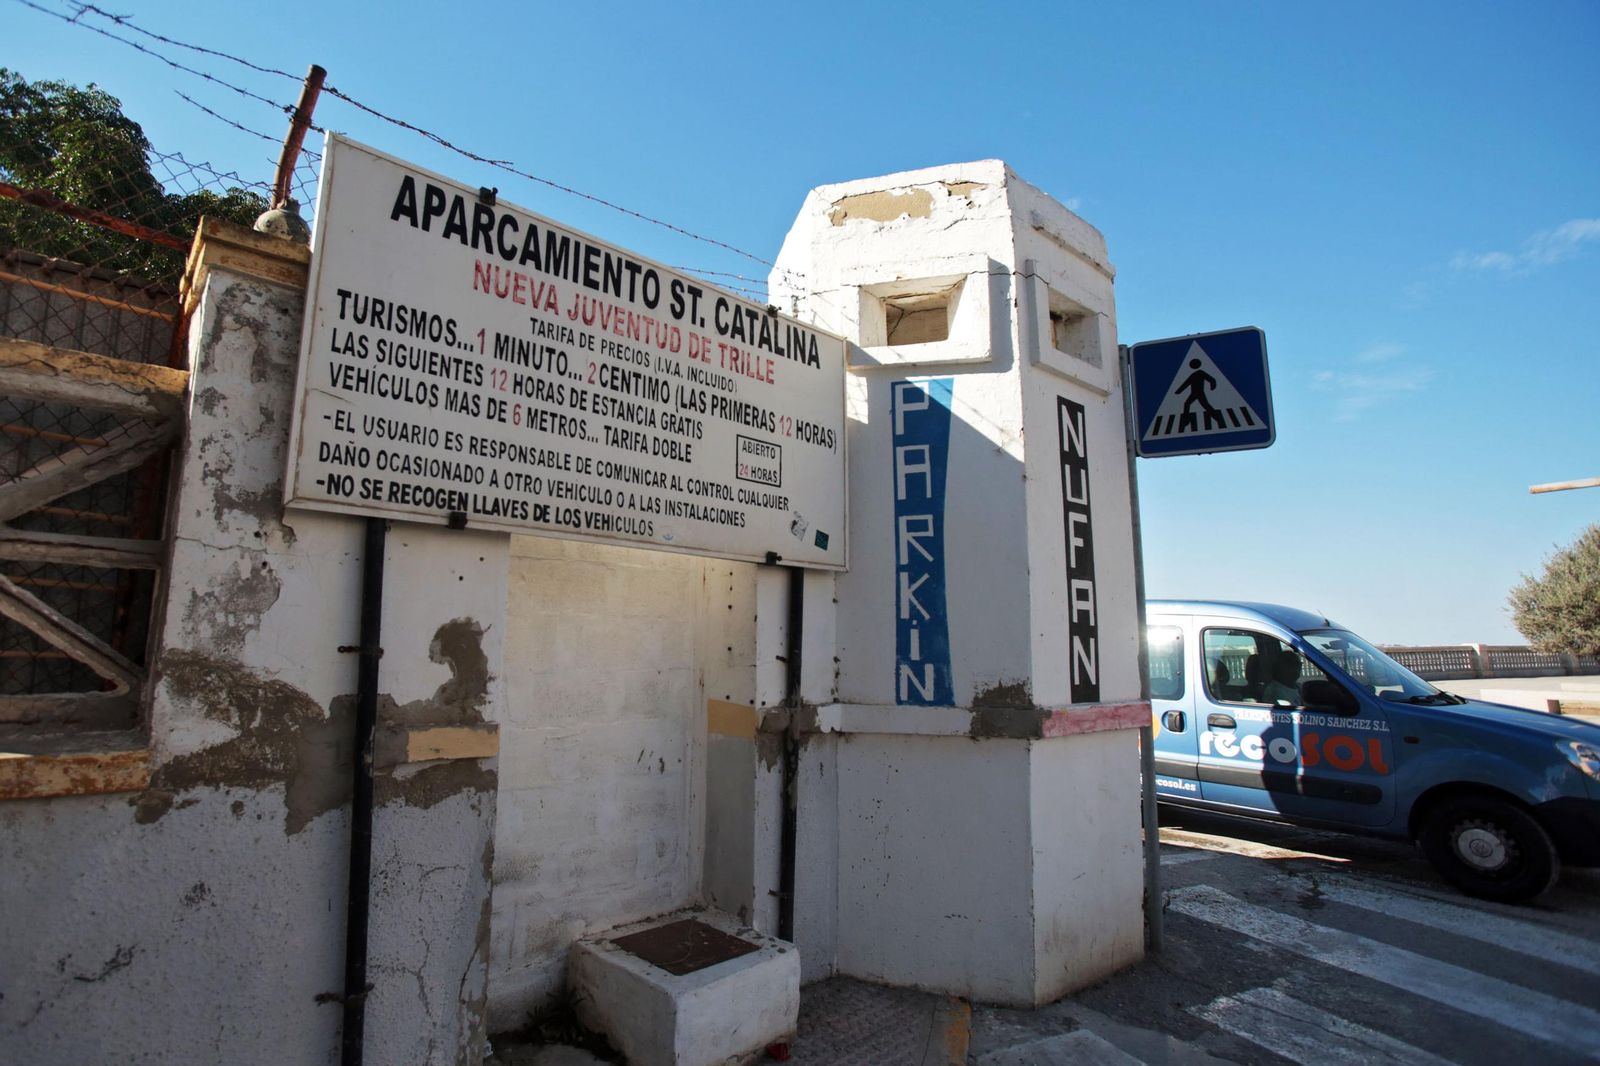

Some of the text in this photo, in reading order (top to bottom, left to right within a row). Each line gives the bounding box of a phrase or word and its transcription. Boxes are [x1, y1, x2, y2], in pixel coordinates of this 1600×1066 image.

[390, 175, 820, 369] APARCAMIENTO ST. CATALINA
[473, 259, 775, 384] NUEVA JUVENTUD DE TRILLE
[530, 317, 574, 346] TARIFA
[579, 332, 595, 351] DE
[601, 338, 650, 367] PRECIOS
[654, 356, 683, 378] (I.V.A.
[329, 362, 439, 407] VEHÍCULOS
[445, 388, 481, 418] MAS
[487, 397, 507, 423] DE
[513, 403, 521, 426] 6
[604, 425, 649, 454] TARIFA
[652, 437, 692, 463] DOBLE
[331, 327, 703, 440] LAS SIGUIENTES 12 HORAS DE ESTANCIA GRATIS
[587, 362, 597, 385] 2
[600, 363, 670, 404] CENTIMO
[676, 384, 707, 413] (LAS
[711, 394, 775, 433] PRIMERAS
[780, 415, 792, 437] 12
[796, 419, 837, 455] HORAS)
[319, 440, 370, 468] DAÑO
[377, 450, 484, 485] OCASIONADO
[489, 469, 499, 488] A
[504, 472, 542, 495] OTRO
[617, 492, 625, 508] O
[628, 493, 636, 510] A
[640, 495, 661, 514] LAS
[665, 499, 746, 528] INSTALACIONES
[363, 415, 439, 448] USUARIO
[444, 431, 464, 452] ES
[469, 436, 571, 471] RESPONSABLE
[576, 456, 592, 474] DE
[597, 460, 667, 489] COMUNICAR
[670, 475, 683, 492] AL
[687, 478, 734, 502] CONTROL
[738, 488, 789, 511] CUALQUIER
[740, 464, 777, 483] 24 HORAS
[742, 440, 776, 459] ABIERTO
[359, 477, 383, 501] SE
[388, 481, 469, 512] RECOGEN
[473, 494, 528, 520] LLAVES
[533, 503, 550, 523] DE
[555, 506, 581, 528] LOS
[894, 383, 935, 702] PARKIN
[1061, 404, 1097, 685] NUFAN
[1327, 716, 1371, 731] SANCHEZ
[1372, 720, 1390, 732] S.L.
